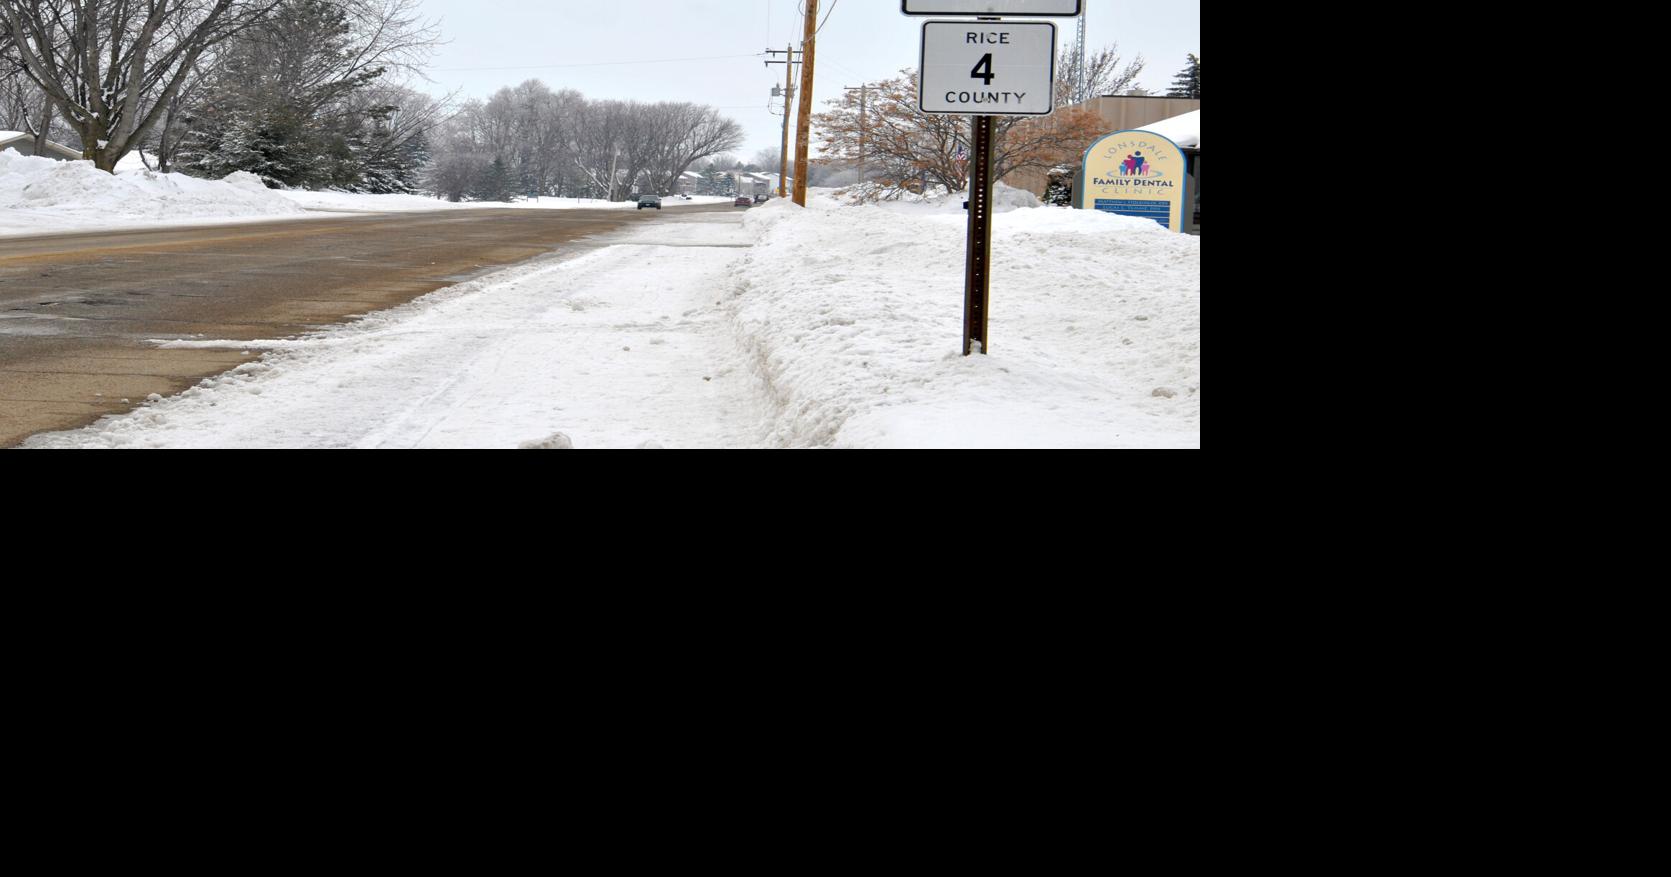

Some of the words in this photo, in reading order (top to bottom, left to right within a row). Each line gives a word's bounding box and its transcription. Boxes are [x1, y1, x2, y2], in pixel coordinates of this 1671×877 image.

[967, 32, 1010, 44] RICE
[971, 53, 995, 85] 4
[945, 91, 1026, 104] COUNTY
[1104, 141, 1167, 160] LONSDALE
[1093, 178, 1131, 186] FAMILY
[1134, 179, 1174, 187] DENTAL
